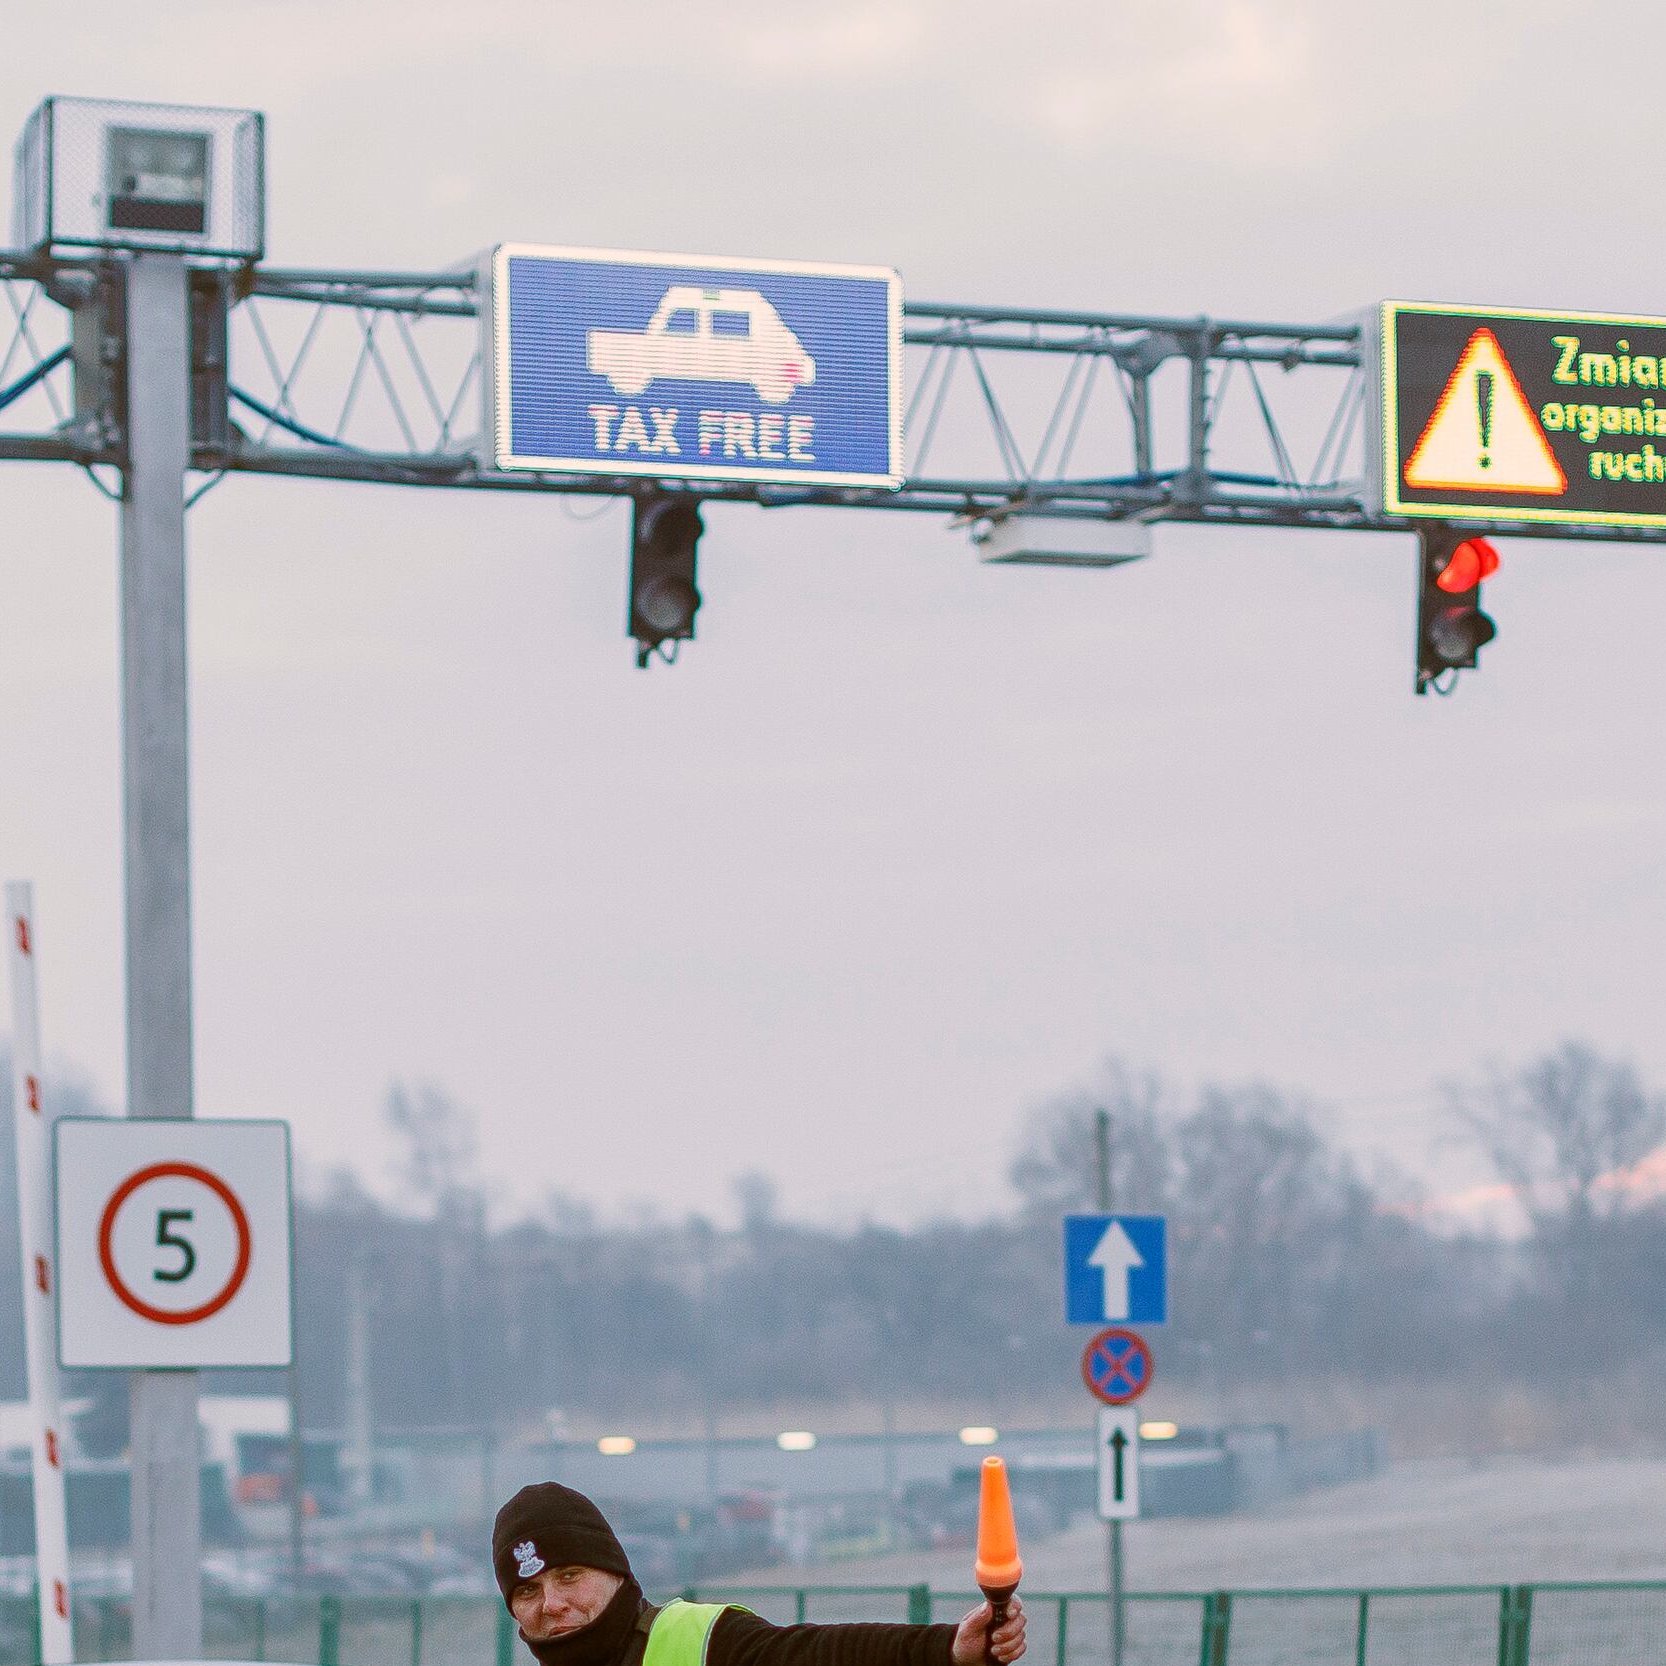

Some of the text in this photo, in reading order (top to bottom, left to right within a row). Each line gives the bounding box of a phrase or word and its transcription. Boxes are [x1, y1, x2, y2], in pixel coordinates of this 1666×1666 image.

[588, 404, 816, 462] TAX FREE
[153, 1209, 196, 1284] 5
